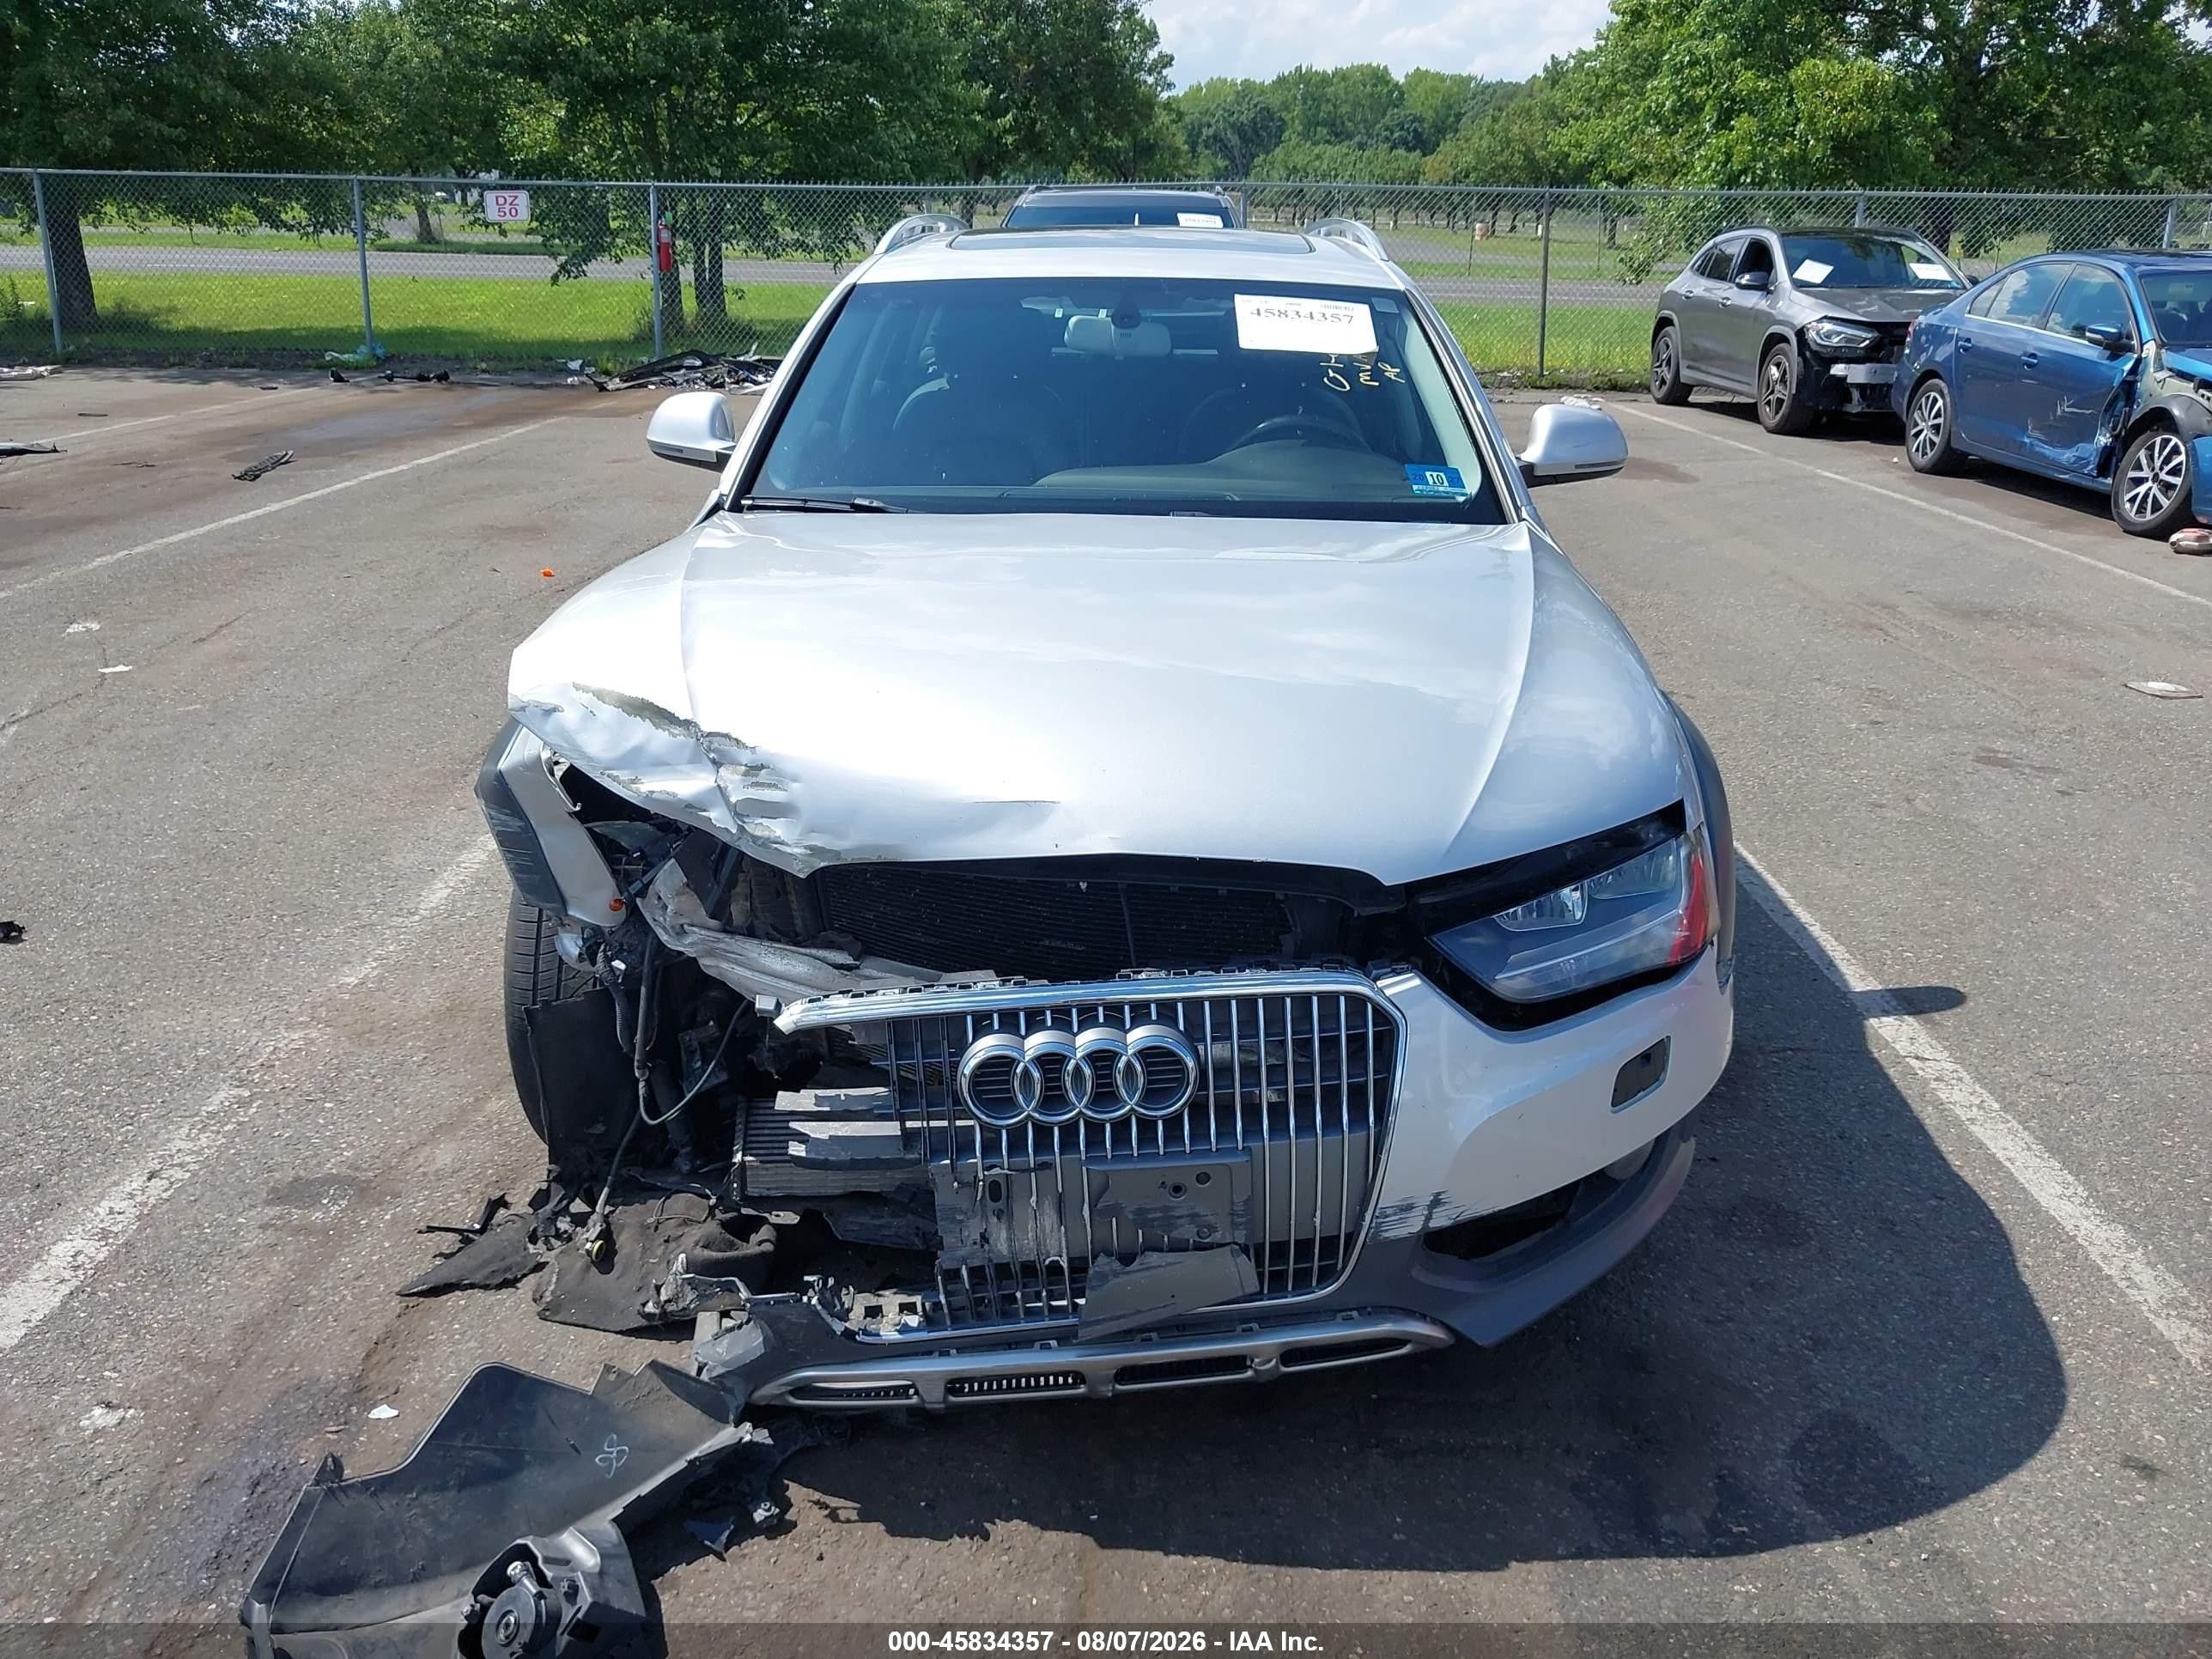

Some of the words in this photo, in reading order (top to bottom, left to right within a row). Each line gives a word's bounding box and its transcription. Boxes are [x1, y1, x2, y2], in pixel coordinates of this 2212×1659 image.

[495, 195, 520, 207] DZ
[497, 207, 519, 218] 50
[1249, 307, 1354, 325] 45834357
[1430, 473, 1444, 485] 10
